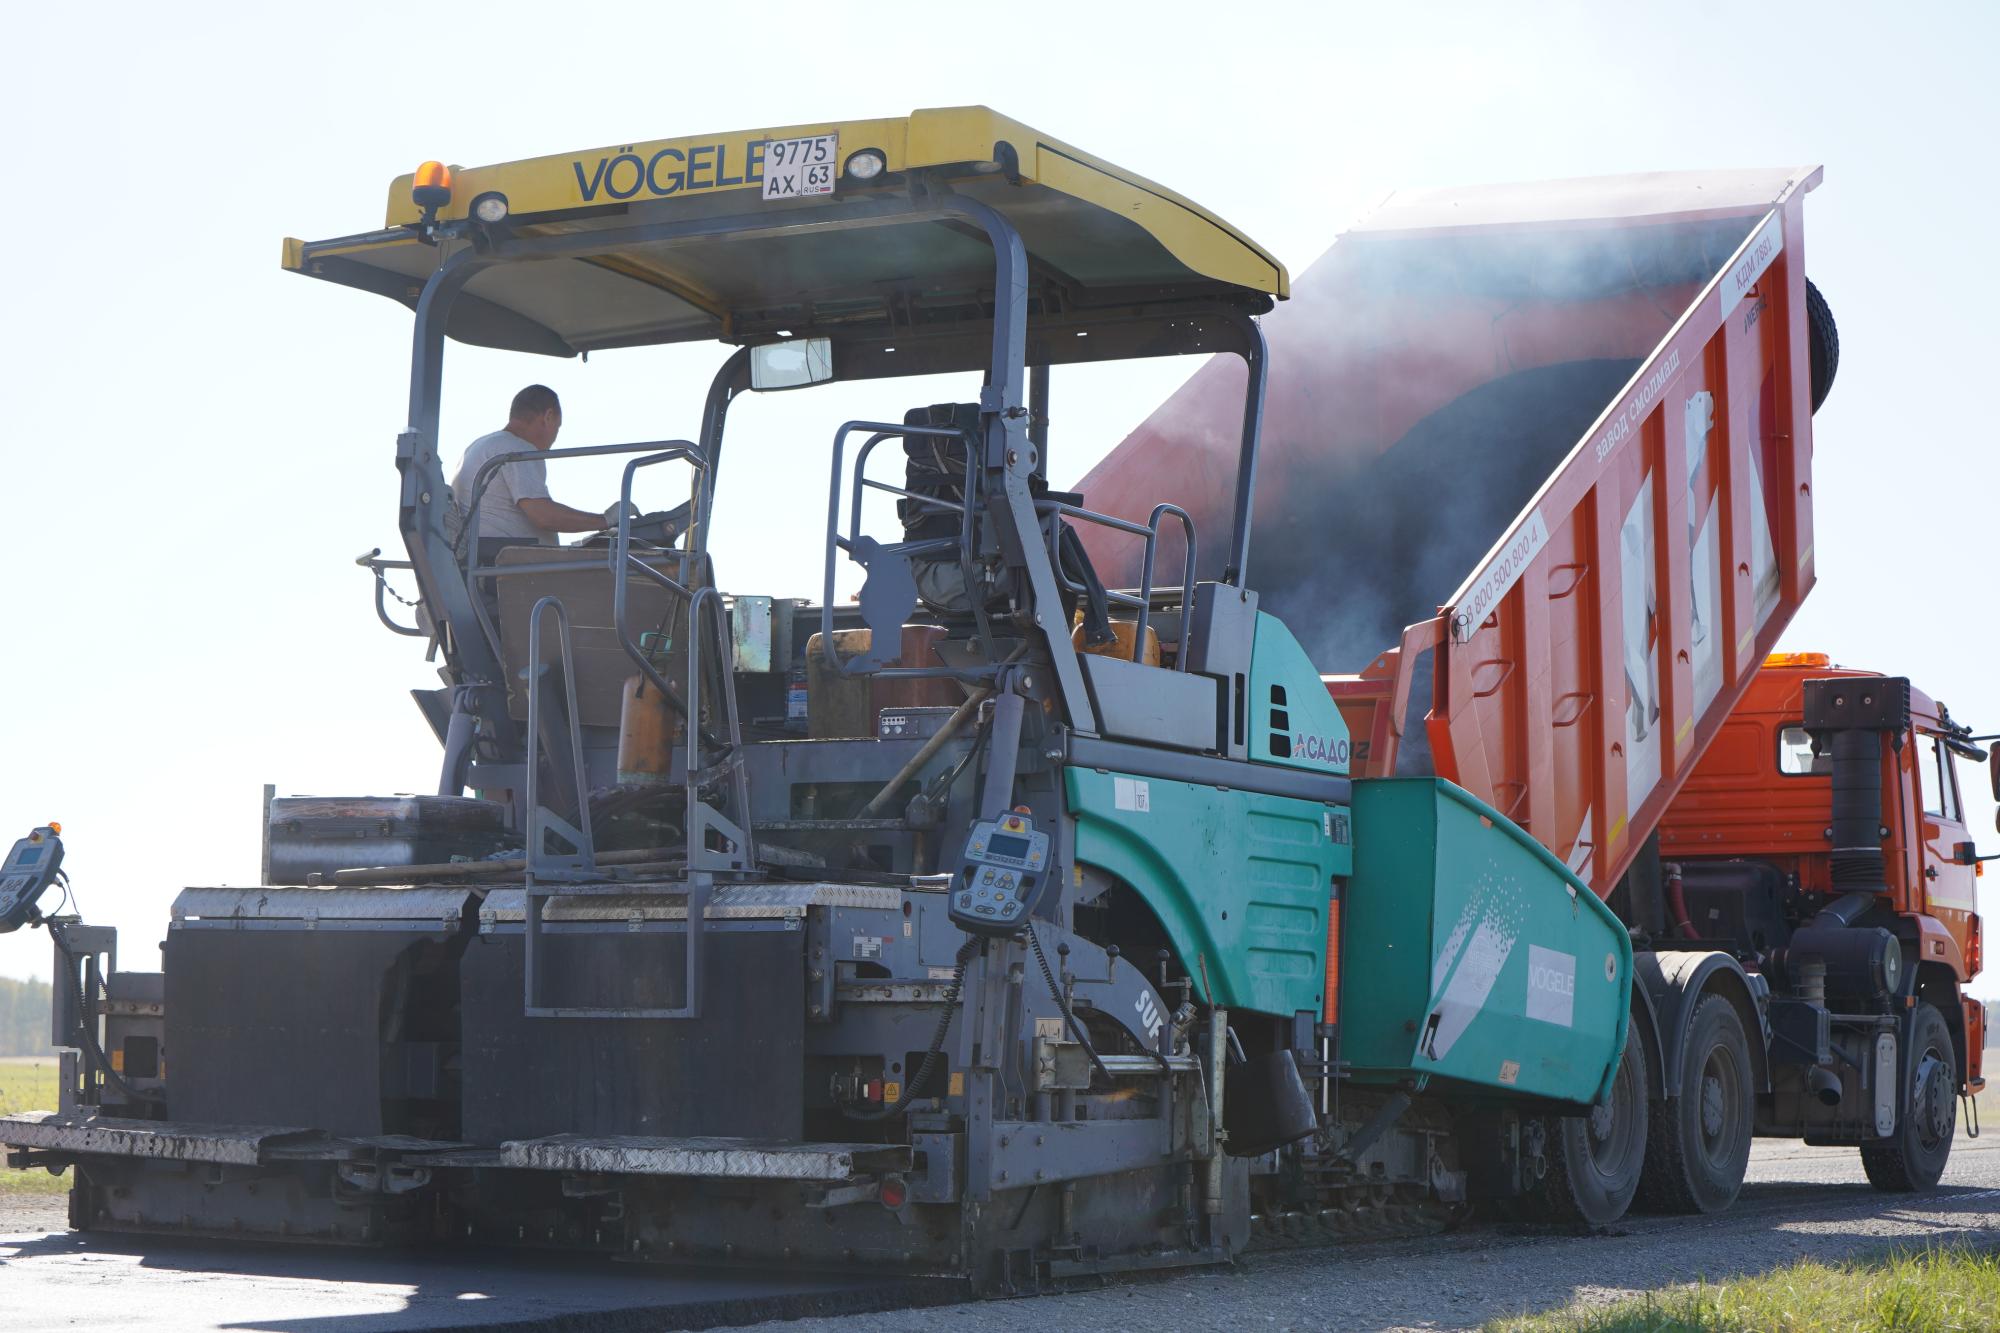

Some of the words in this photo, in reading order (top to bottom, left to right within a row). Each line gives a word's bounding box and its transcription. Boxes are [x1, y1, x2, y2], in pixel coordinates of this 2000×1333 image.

[774, 138, 827, 166] 9775
[573, 140, 766, 201] VÖGELE
[808, 166, 829, 185] 63
[768, 174, 795, 195] AX
